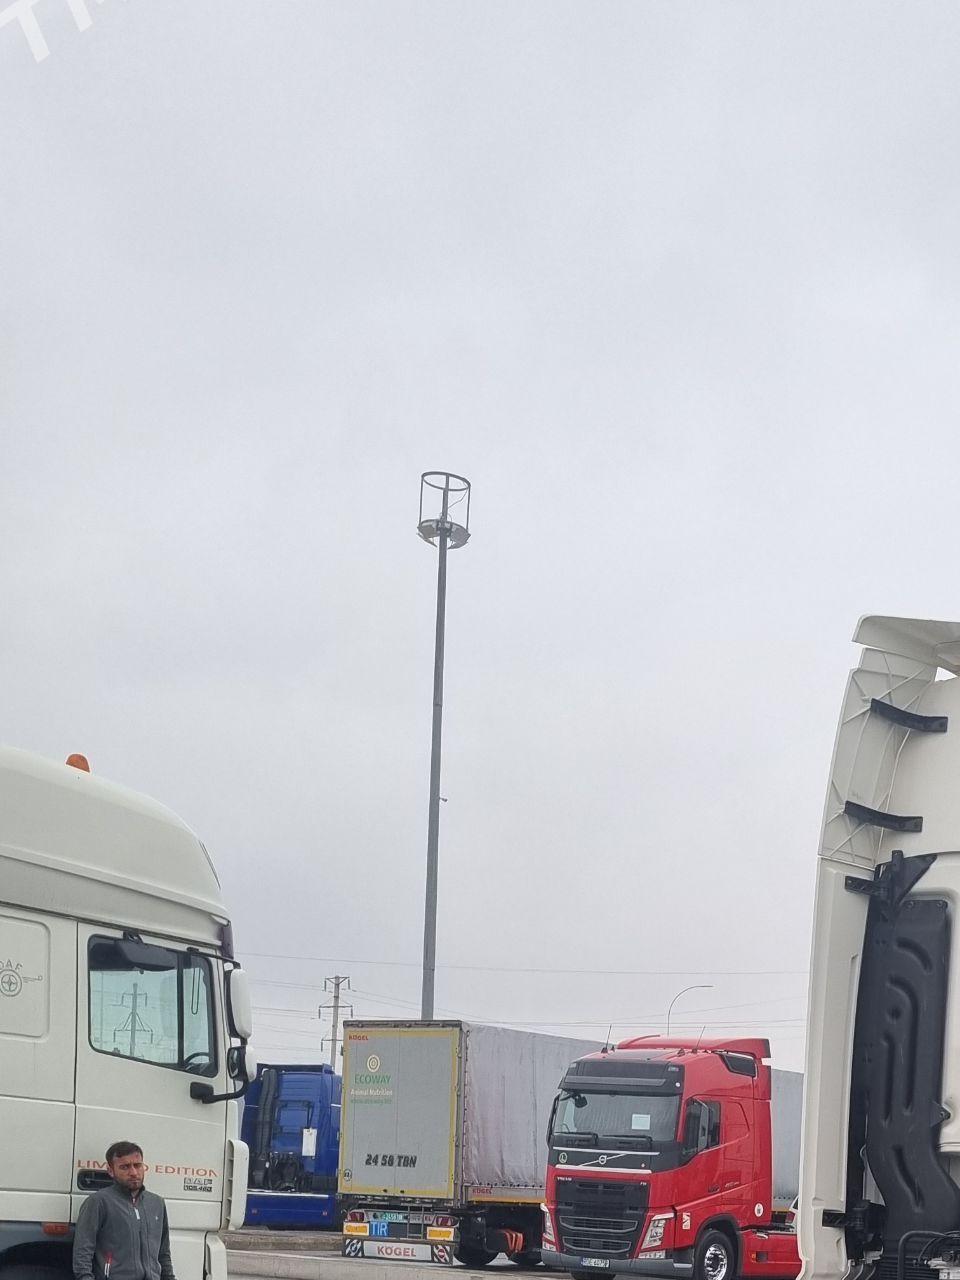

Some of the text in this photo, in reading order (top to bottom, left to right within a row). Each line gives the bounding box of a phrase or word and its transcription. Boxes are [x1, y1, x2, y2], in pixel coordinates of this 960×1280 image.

[354, 1074, 392, 1085] ECOWAY
[350, 1087, 369, 1096] Animal
[155, 1165, 219, 1177] EDITION
[370, 1221, 388, 1237] TIR
[377, 1245, 417, 1258] KÖGEL
